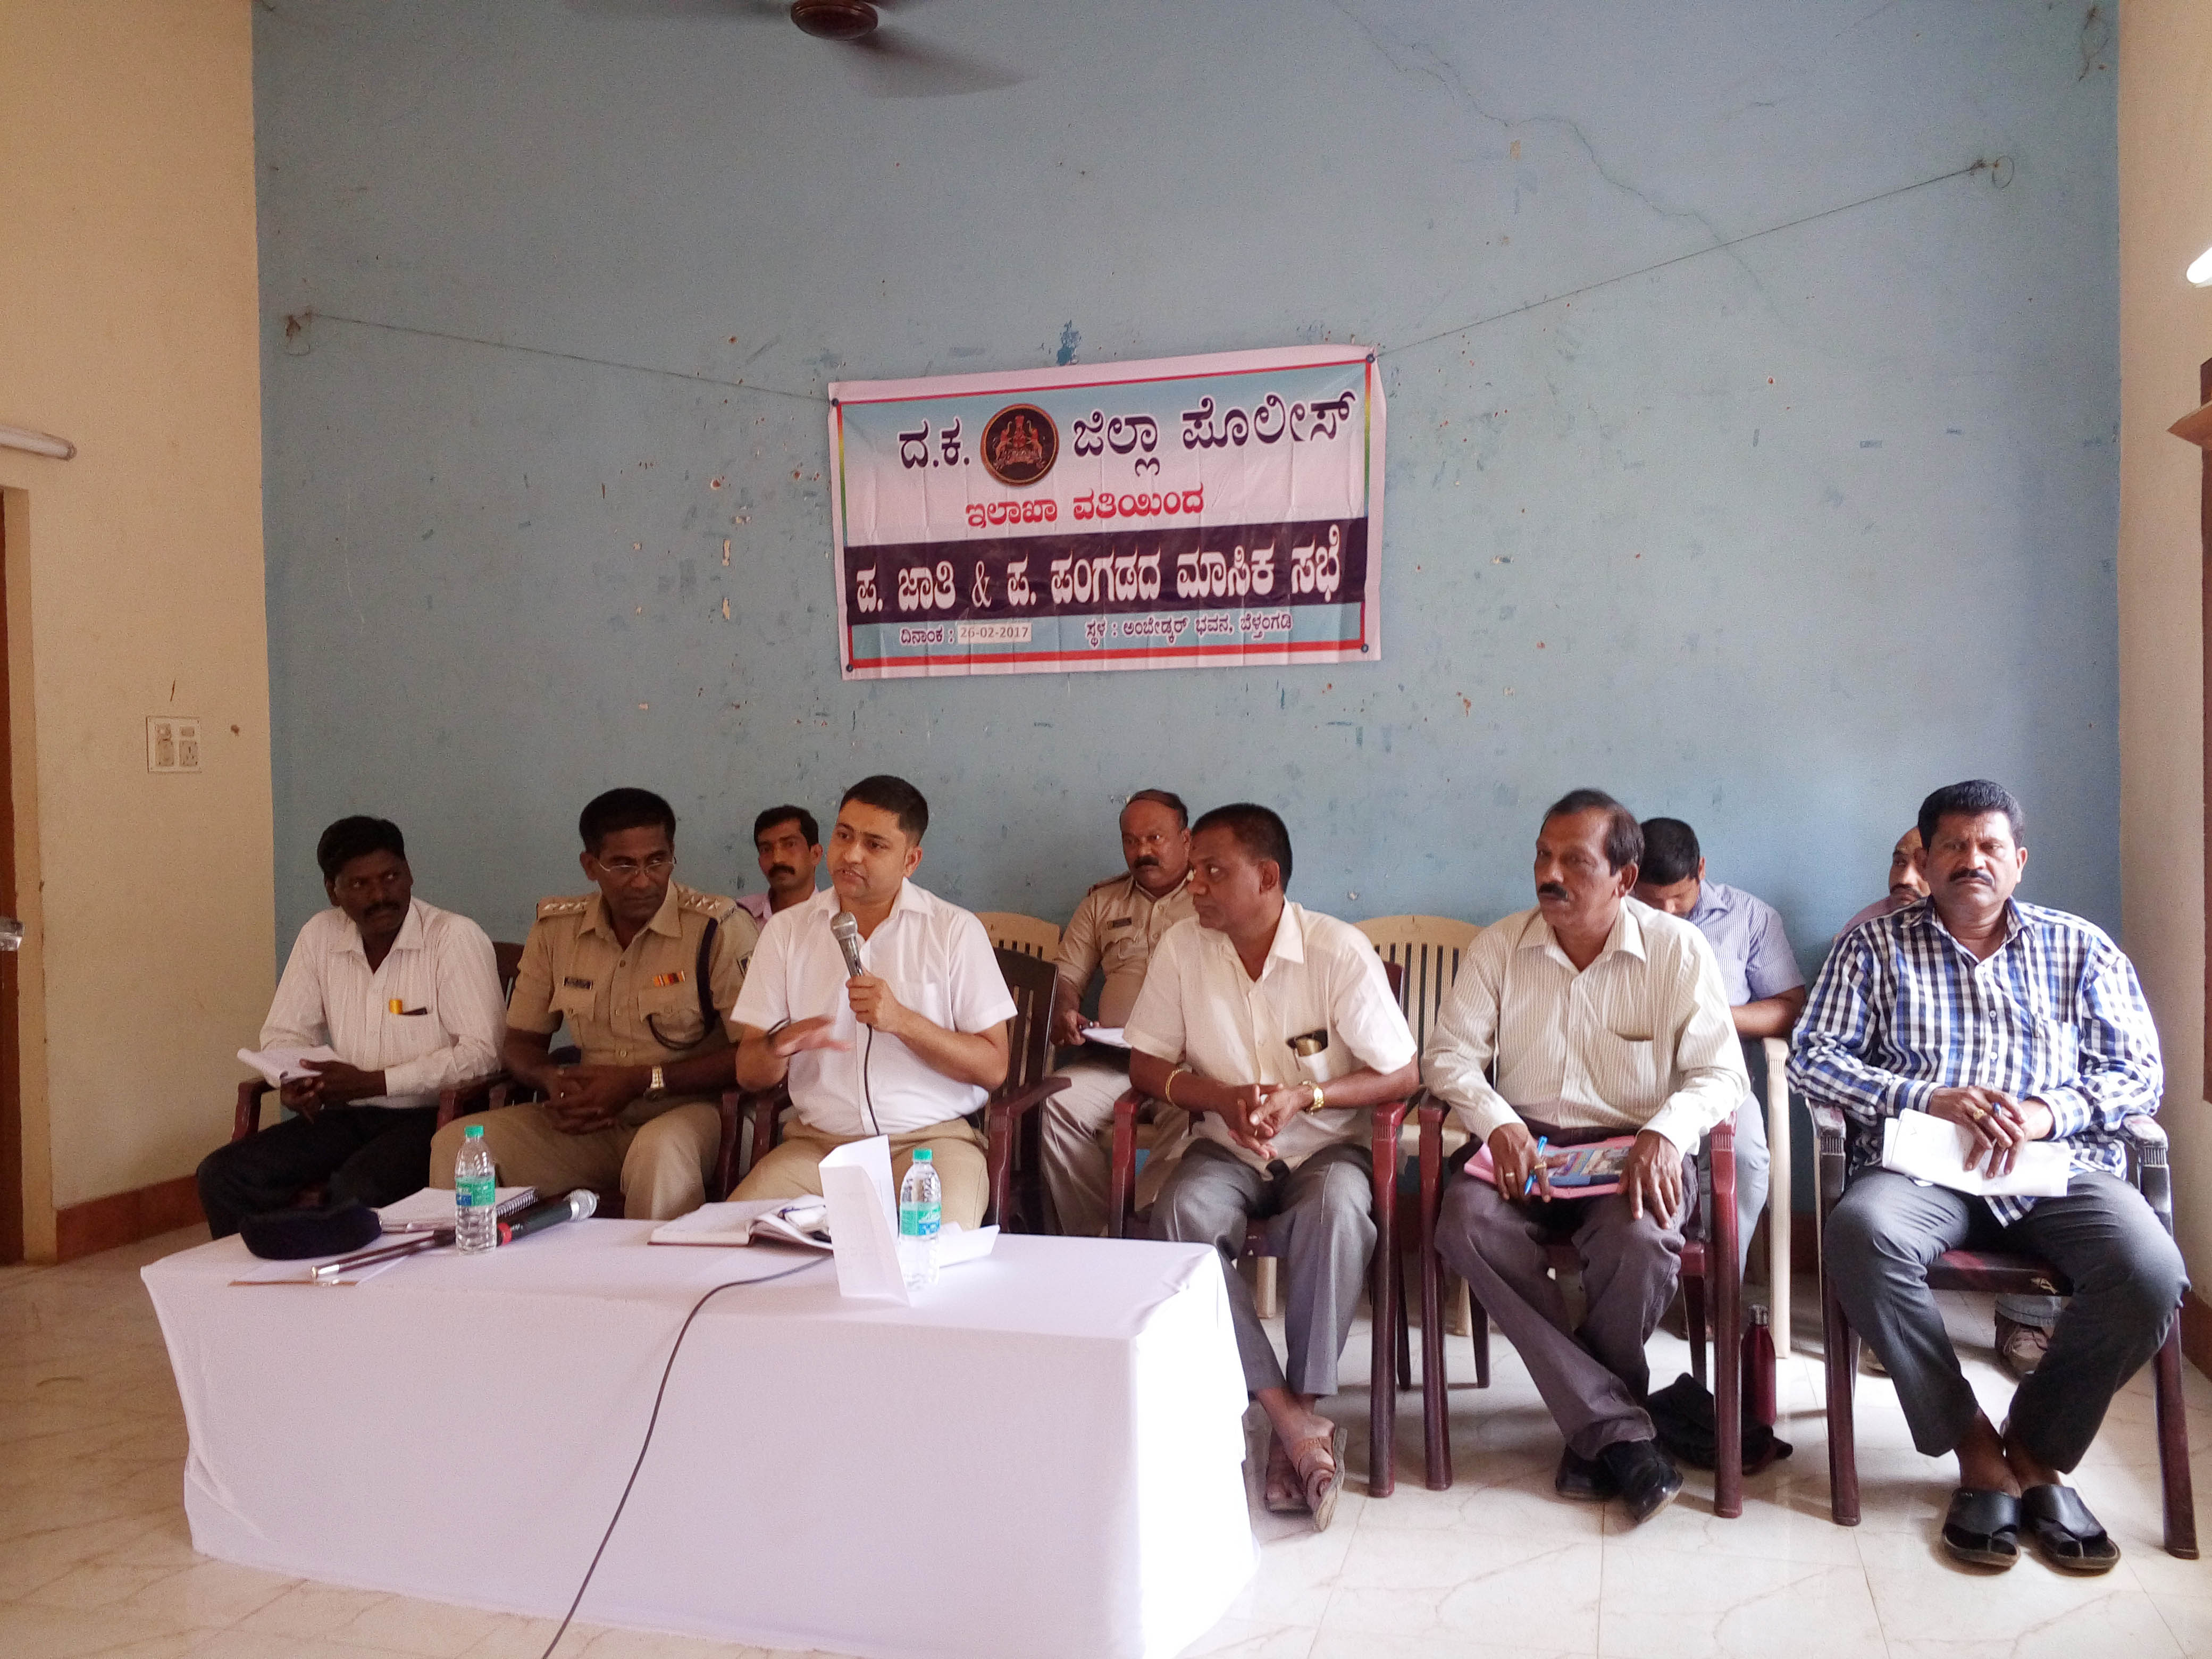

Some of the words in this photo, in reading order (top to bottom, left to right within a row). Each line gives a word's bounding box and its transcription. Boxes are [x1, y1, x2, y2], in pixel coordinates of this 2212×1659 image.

[899, 417, 970, 469] ದ.ಕ.
[1073, 409, 1160, 476] ಜಿಲ್ಲಾ
[1182, 391, 1356, 449] ಪೊಲೀಸ್
[965, 499, 1058, 529] ಇಲಾಖಾ
[1073, 482, 1204, 521] ವತಿಯಿಂದ
[856, 563, 884, 613] ಪ.
[898, 560, 957, 613] ಜಾತಿ
[971, 560, 992, 608] &
[1007, 554, 1037, 606] ಪ.
[1050, 543, 1161, 605] ಪಂಗಡದ
[1176, 538, 1276, 599] ಮಾಸಿಕ
[1291, 524, 1341, 602] ಸಭೆ
[901, 626, 943, 644] ದಿನಾಂಕ
[960, 627, 1029, 639] 26-02-2017
[1087, 620, 1106, 647] ಸ್ಥಳ
